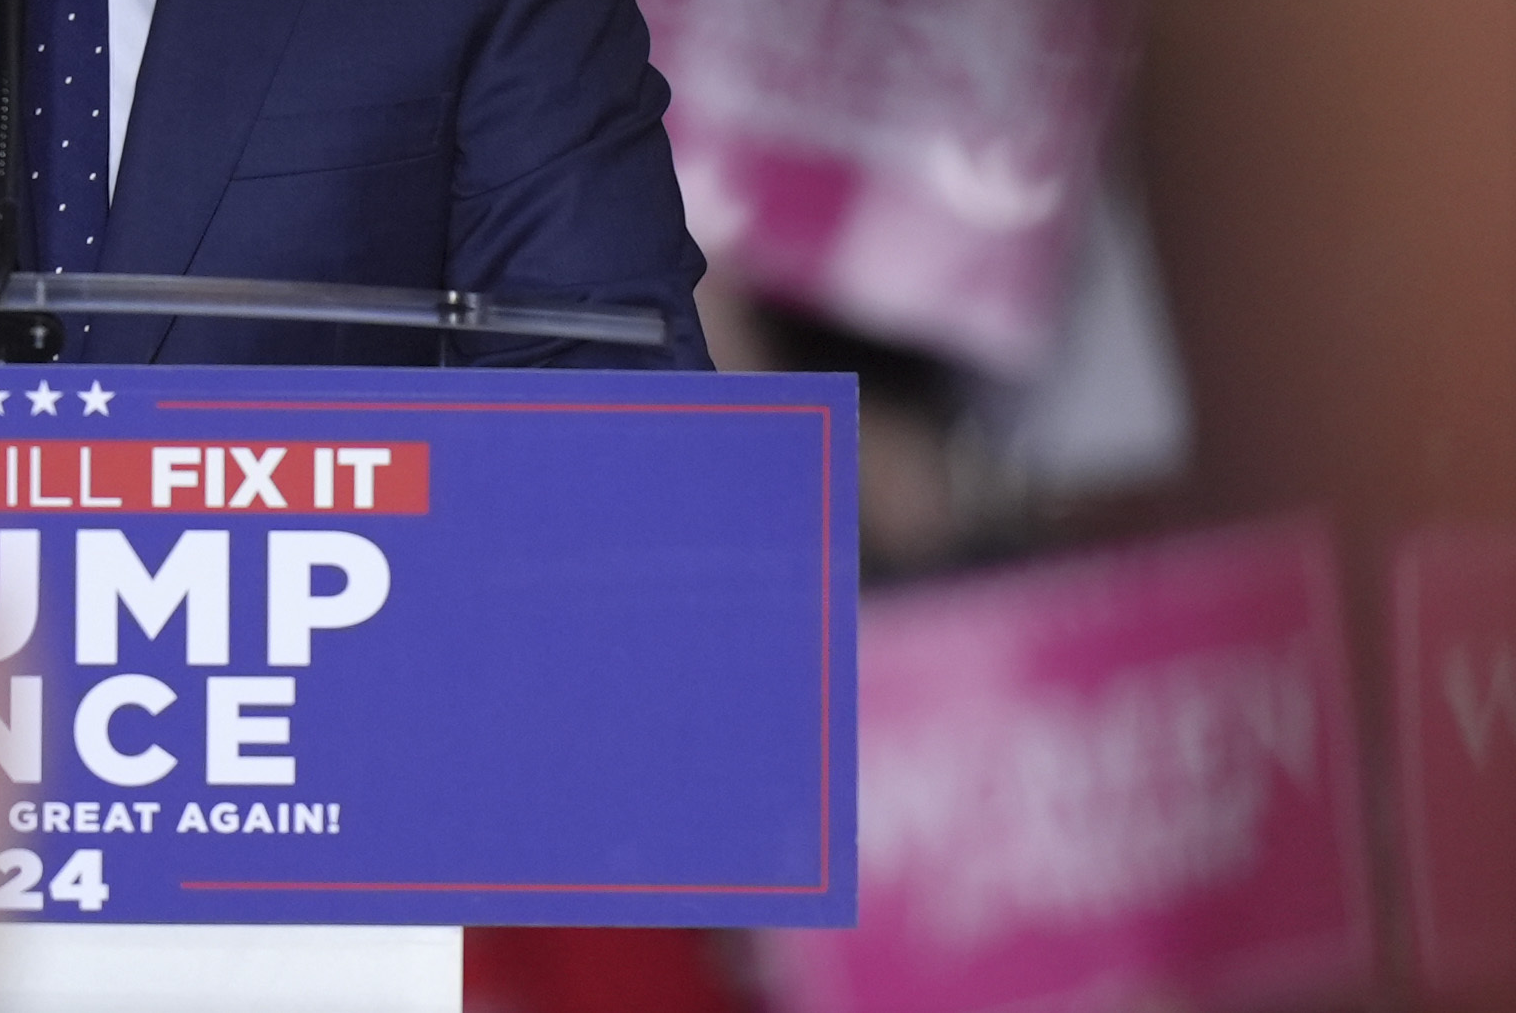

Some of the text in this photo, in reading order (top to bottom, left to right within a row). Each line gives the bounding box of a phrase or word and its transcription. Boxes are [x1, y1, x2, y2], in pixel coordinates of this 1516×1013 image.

[150, 445, 289, 509] FIX
[313, 446, 393, 509] IT
[7, 799, 162, 835] GREAT
[176, 801, 342, 835] AGAIN!
